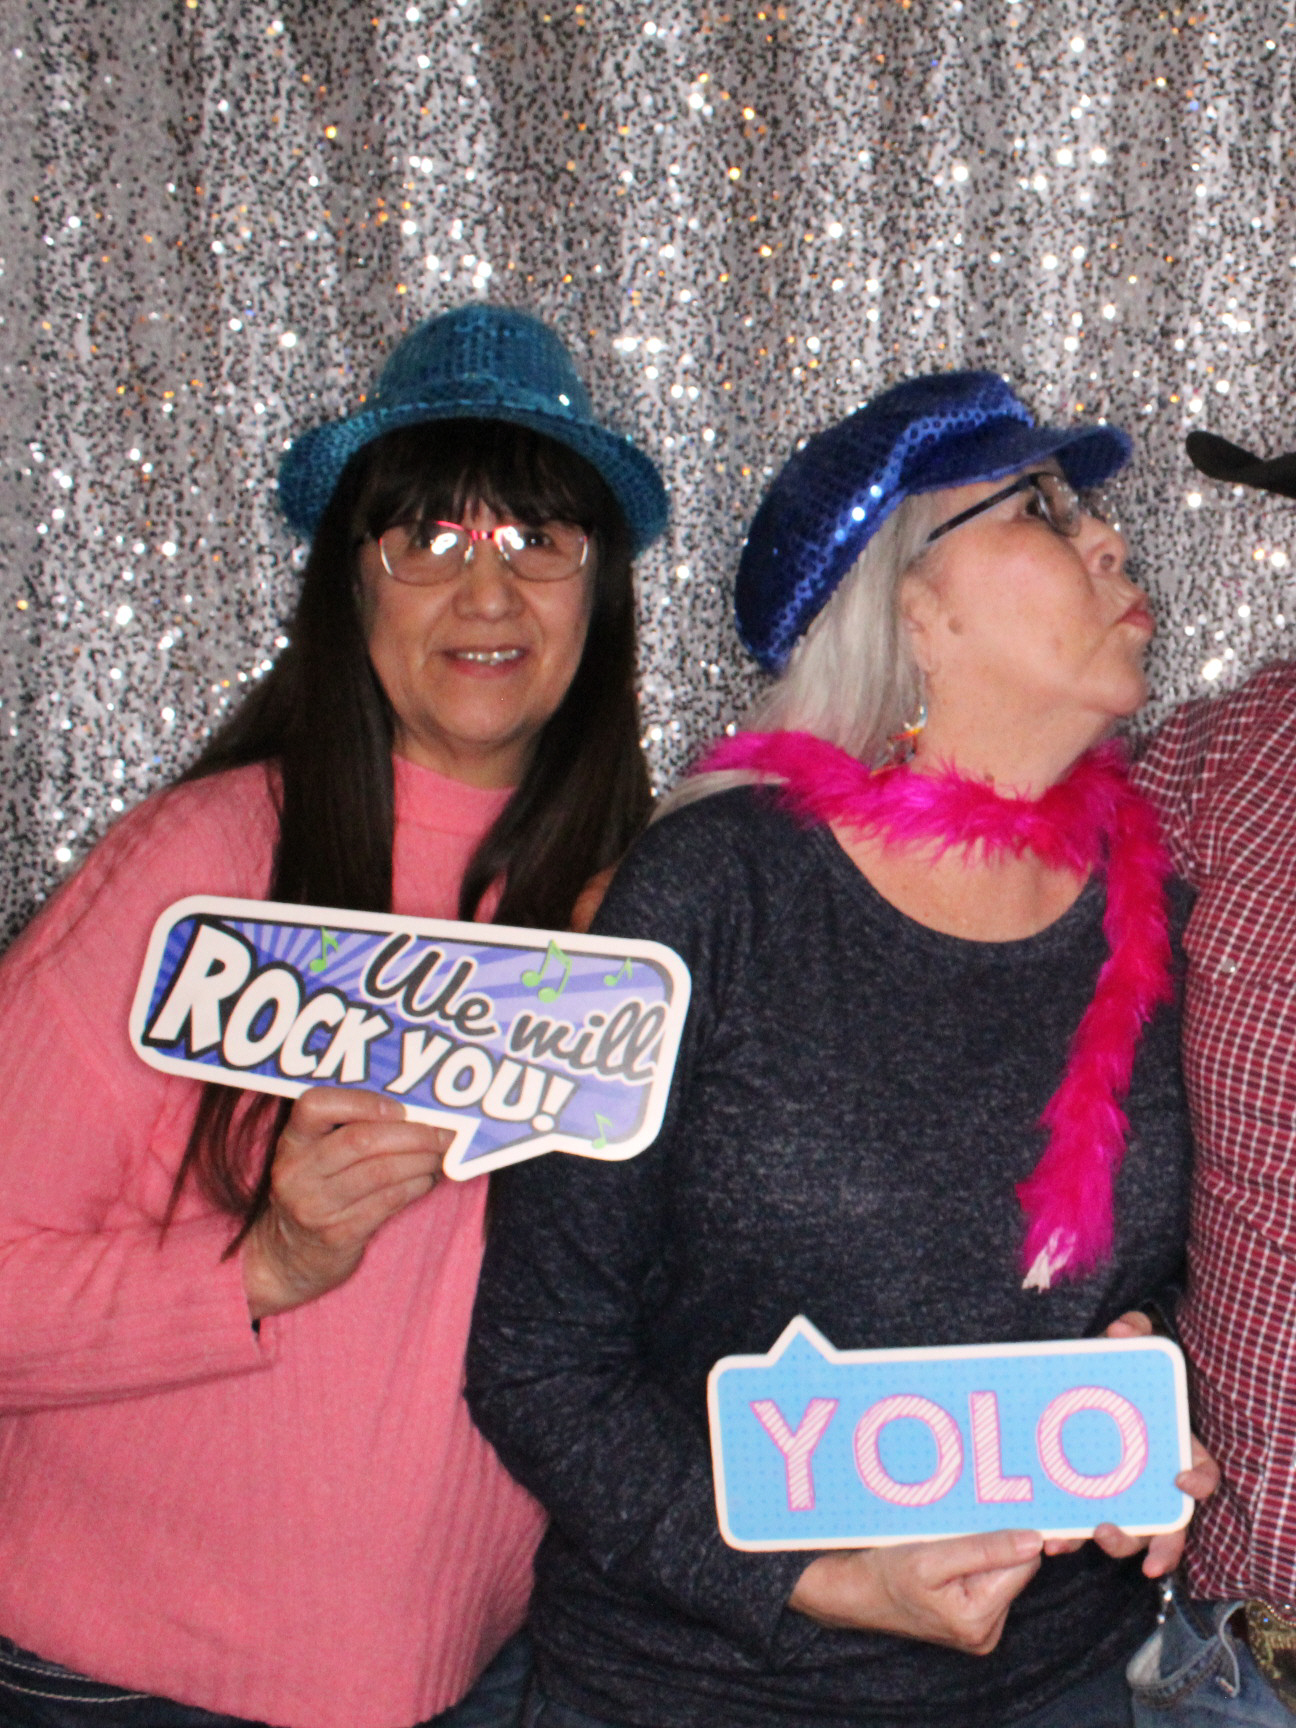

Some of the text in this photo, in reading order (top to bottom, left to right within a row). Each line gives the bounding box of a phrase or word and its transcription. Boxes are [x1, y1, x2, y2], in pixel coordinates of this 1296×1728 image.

[143, 919, 582, 1132] ROCK YOU!
[363, 932, 665, 1083] We will
[749, 1385, 1150, 1512] YOLO
